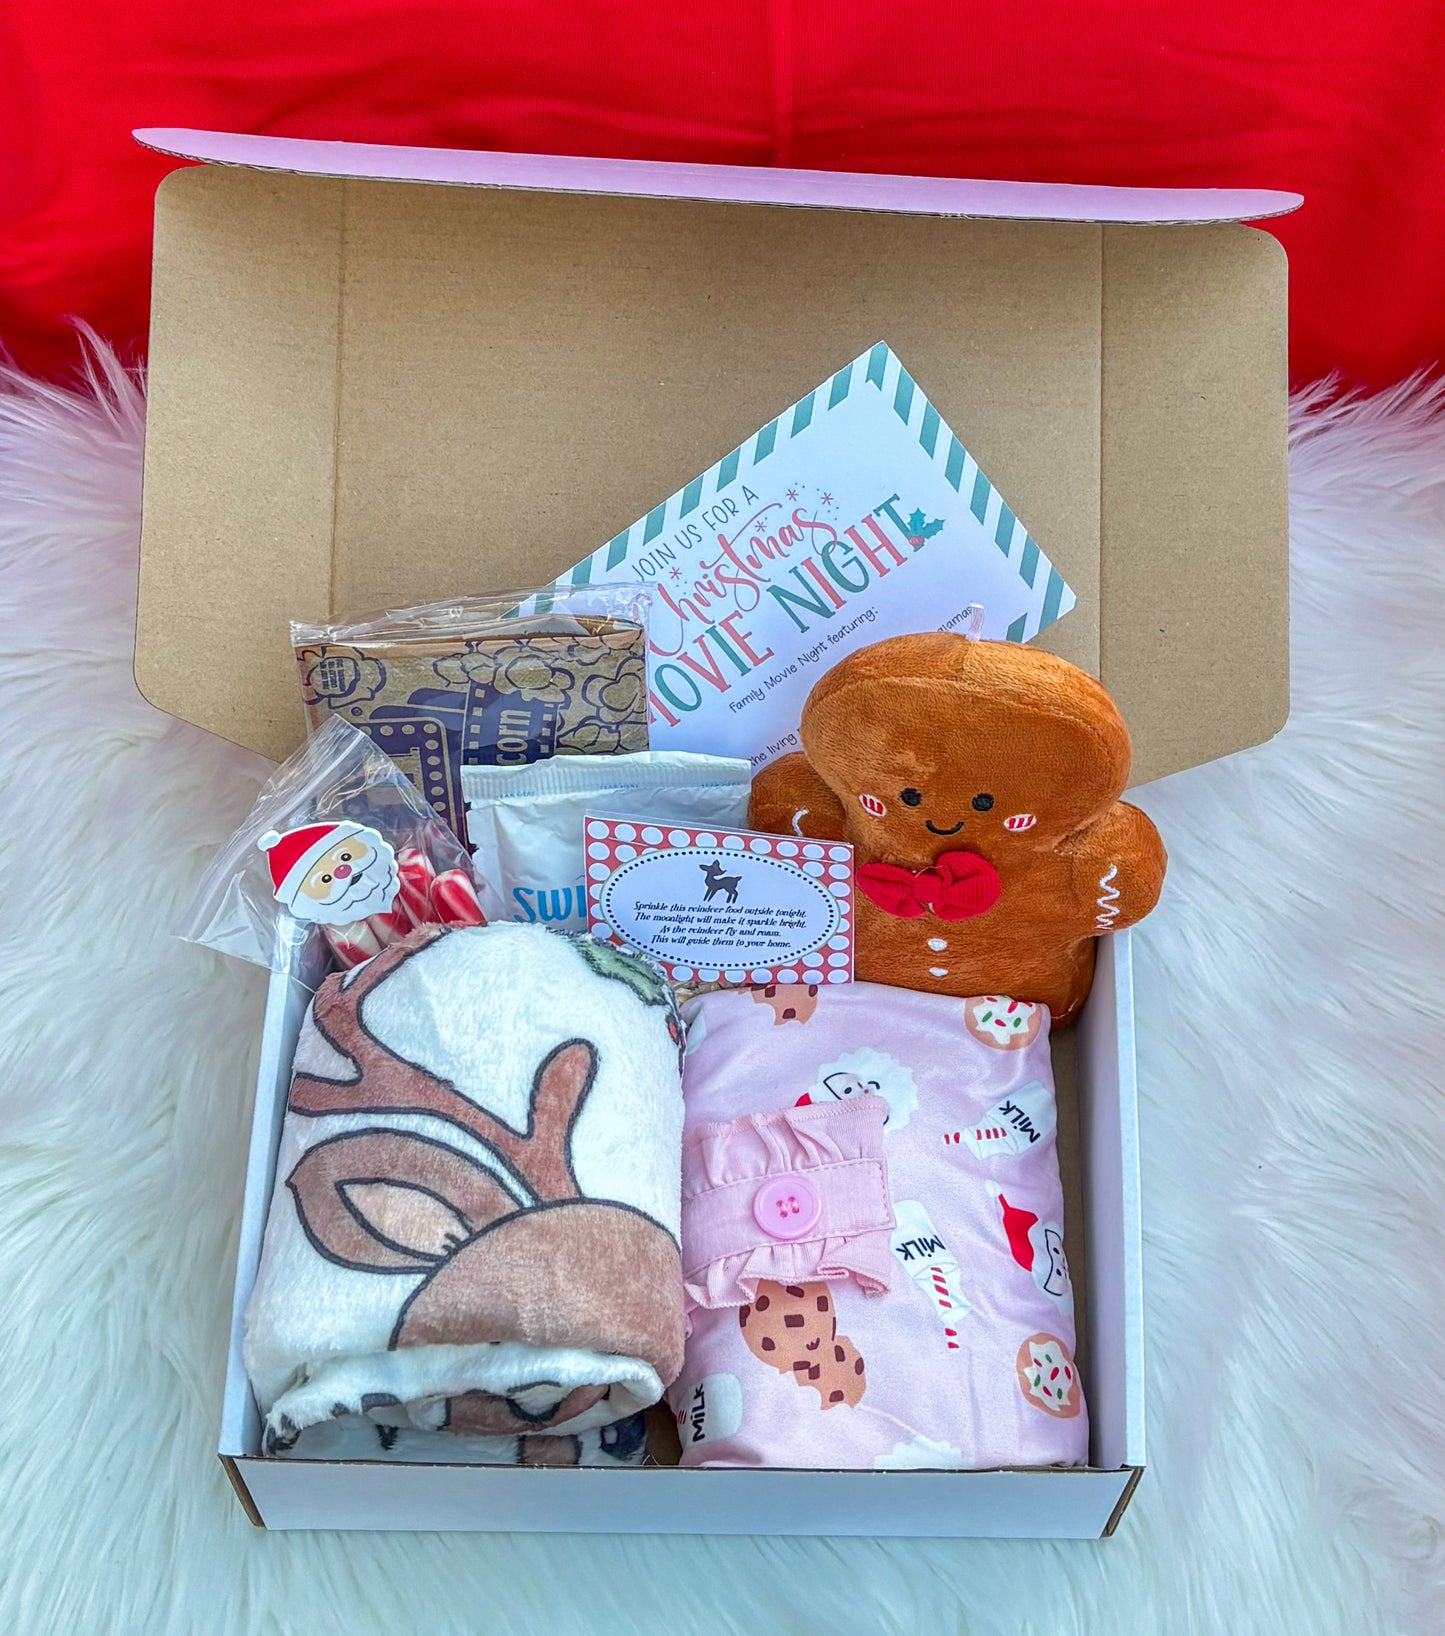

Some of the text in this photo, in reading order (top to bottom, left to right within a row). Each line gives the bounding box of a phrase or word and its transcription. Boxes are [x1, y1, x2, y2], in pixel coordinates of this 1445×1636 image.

[631, 485, 760, 582] JOIN US FOR A
[766, 493, 927, 634] NIGHT
[728, 606, 879, 713] Family Movie Night featuring:
[766, 733, 798, 754] living
[633, 901, 807, 918] Sprinkle this reindeer food outside tonight.
[634, 911, 807, 929] The moonlight will make it sparkle bright.
[659, 924, 671, 934] As
[672, 925, 687, 934] the
[687, 926, 724, 935] reindeer
[725, 926, 738, 936] fly
[738, 927, 757, 936] and
[651, 934, 669, 944] This
[671, 936, 687, 944] will
[686, 937, 711, 946] guide
[711, 938, 734, 946] them
[735, 939, 744, 947] to
[766, 939, 792, 948] home.
